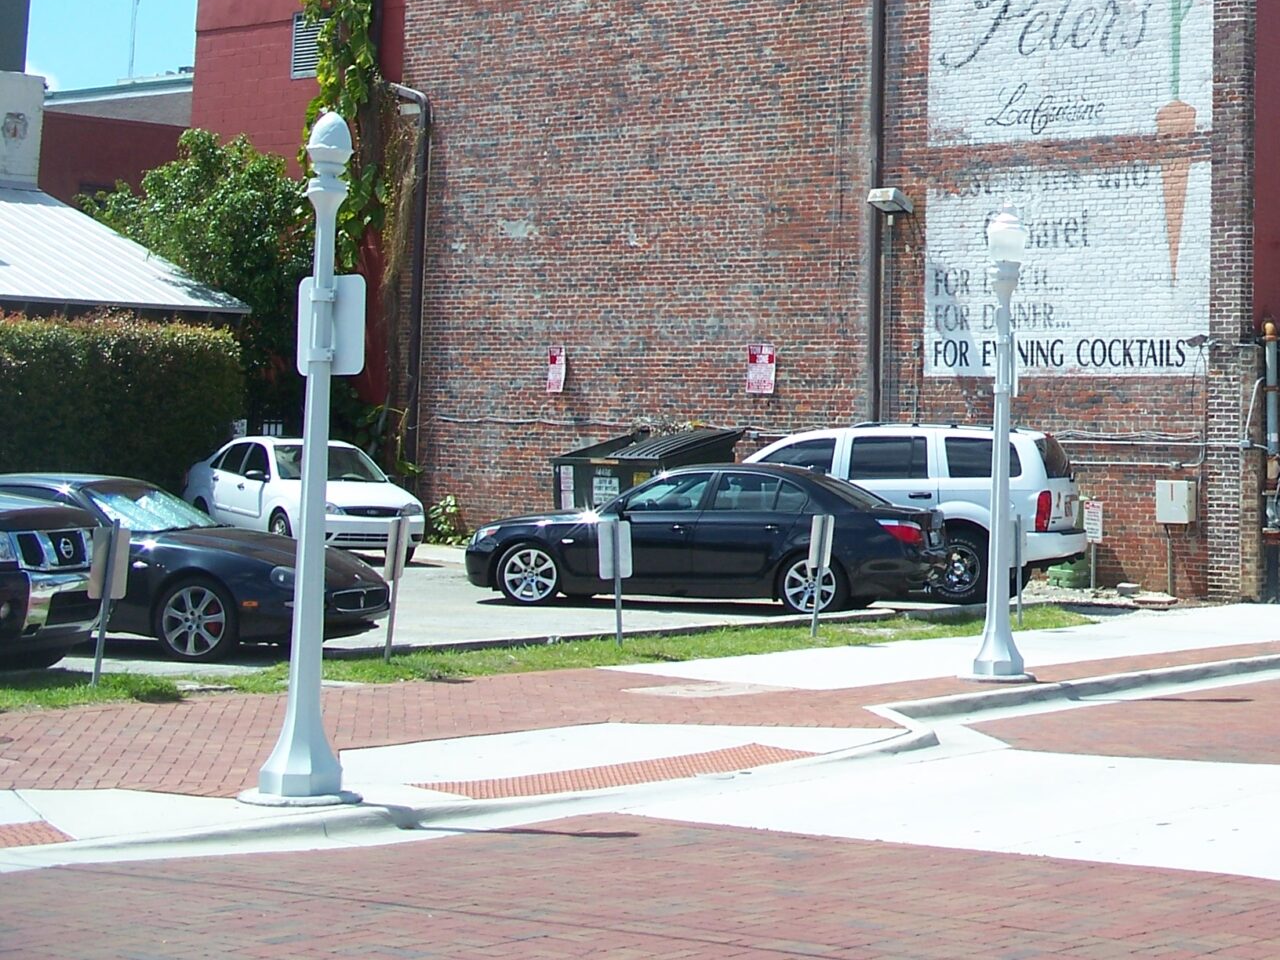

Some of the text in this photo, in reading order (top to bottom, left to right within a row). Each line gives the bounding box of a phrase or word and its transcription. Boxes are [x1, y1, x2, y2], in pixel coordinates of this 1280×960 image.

[933, 267, 970, 297] FOR
[933, 303, 1071, 332] FOR DNNER...
[933, 338, 1187, 368] FOR ENING COCKTAILS
